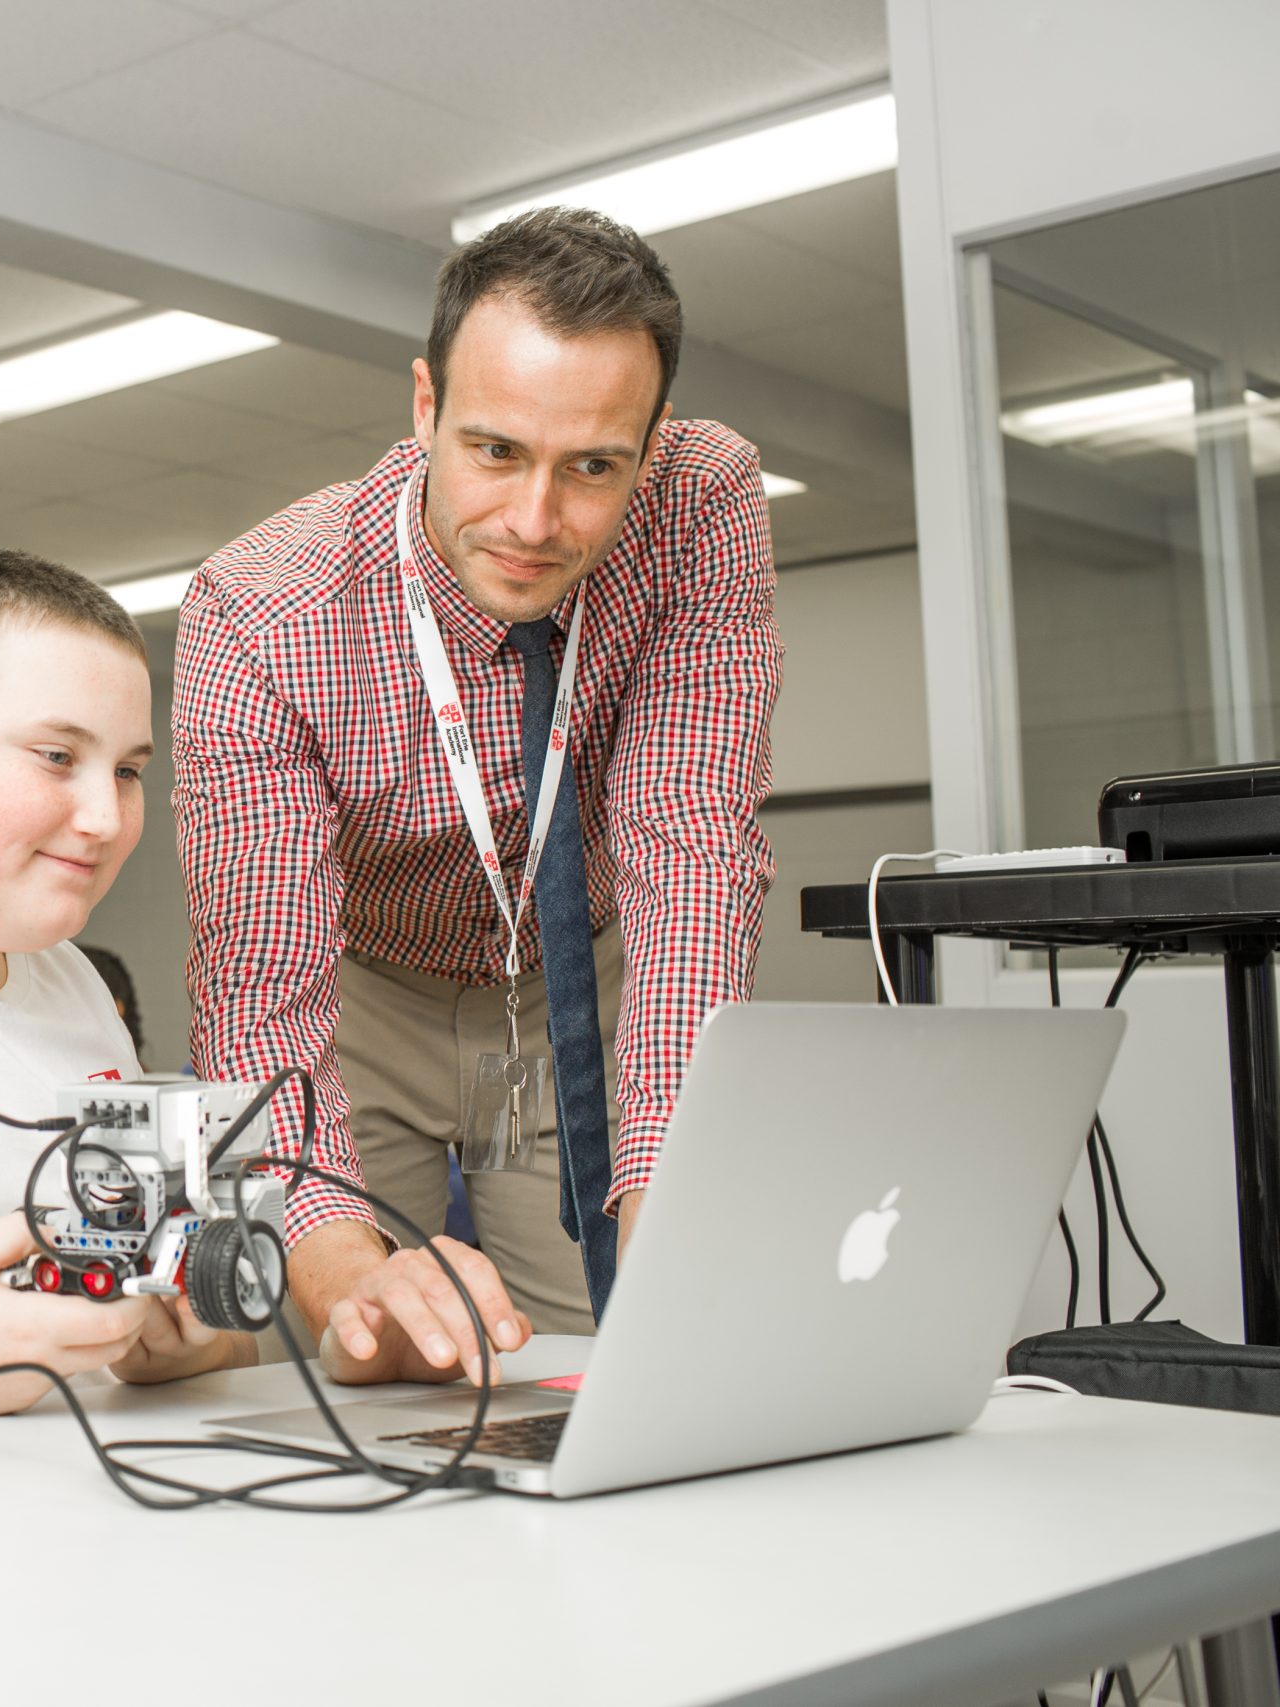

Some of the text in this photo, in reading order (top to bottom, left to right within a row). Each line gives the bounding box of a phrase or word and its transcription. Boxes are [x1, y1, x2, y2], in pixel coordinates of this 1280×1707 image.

[407, 583, 416, 611] Academy
[414, 579, 422, 592] Fort
[410, 581, 426, 619] International
[445, 728, 457, 756] Academy
[452, 726, 467, 765] International
[458, 724, 469, 751] Fort Erie
